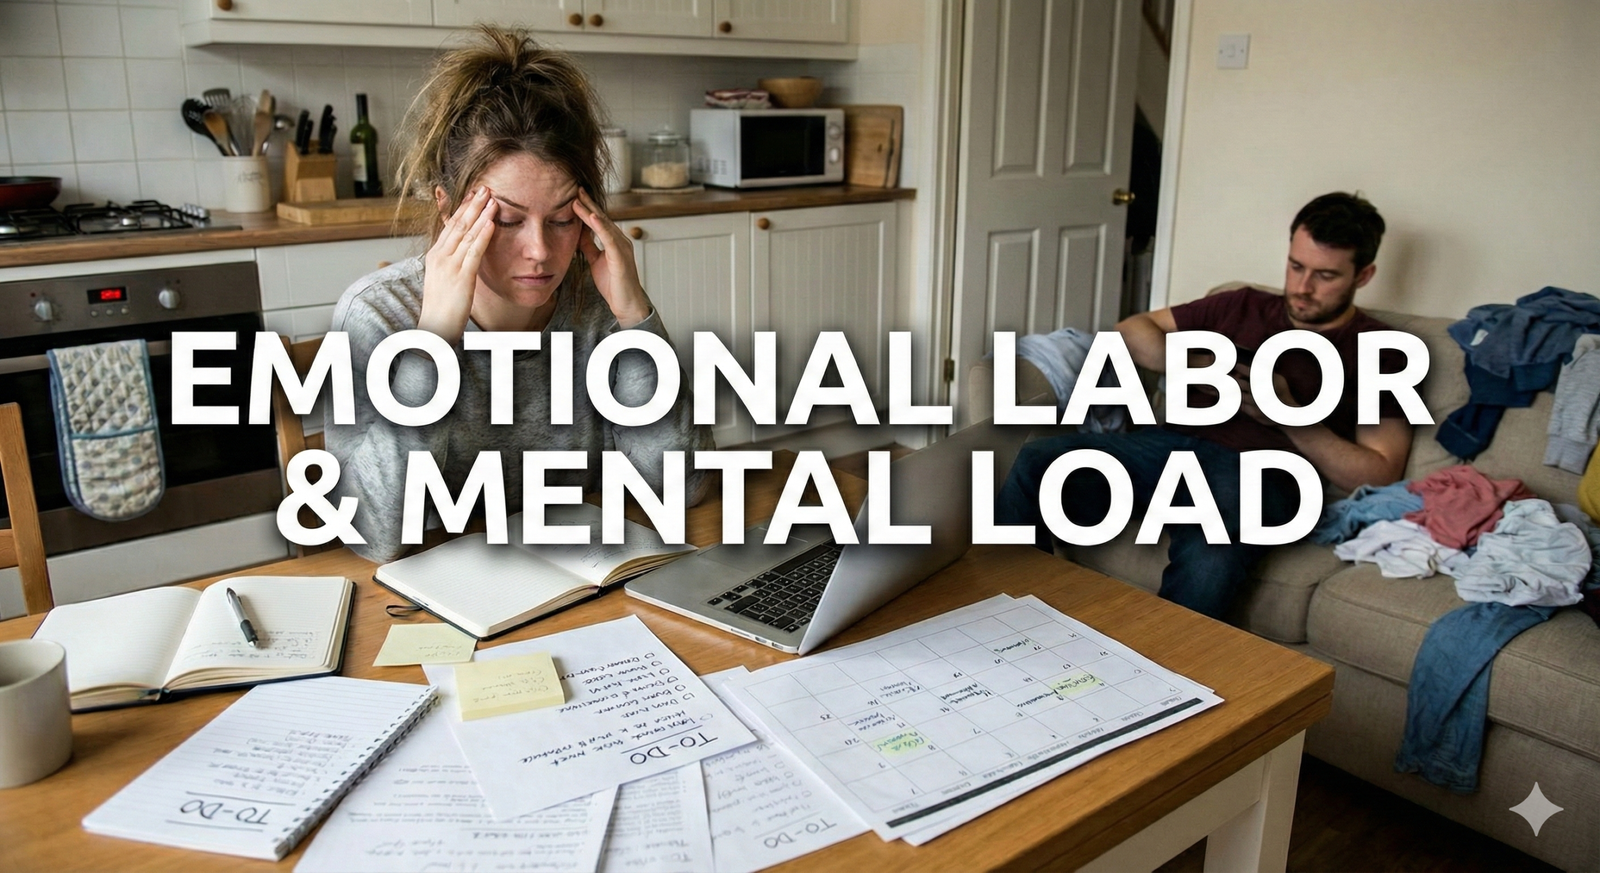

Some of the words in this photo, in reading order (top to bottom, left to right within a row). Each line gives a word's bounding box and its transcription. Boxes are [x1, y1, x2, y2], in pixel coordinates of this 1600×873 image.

[629, 731, 719, 765] TO-DO
[180, 799, 271, 825] TO-DO
[763, 818, 838, 849] TO-DO
